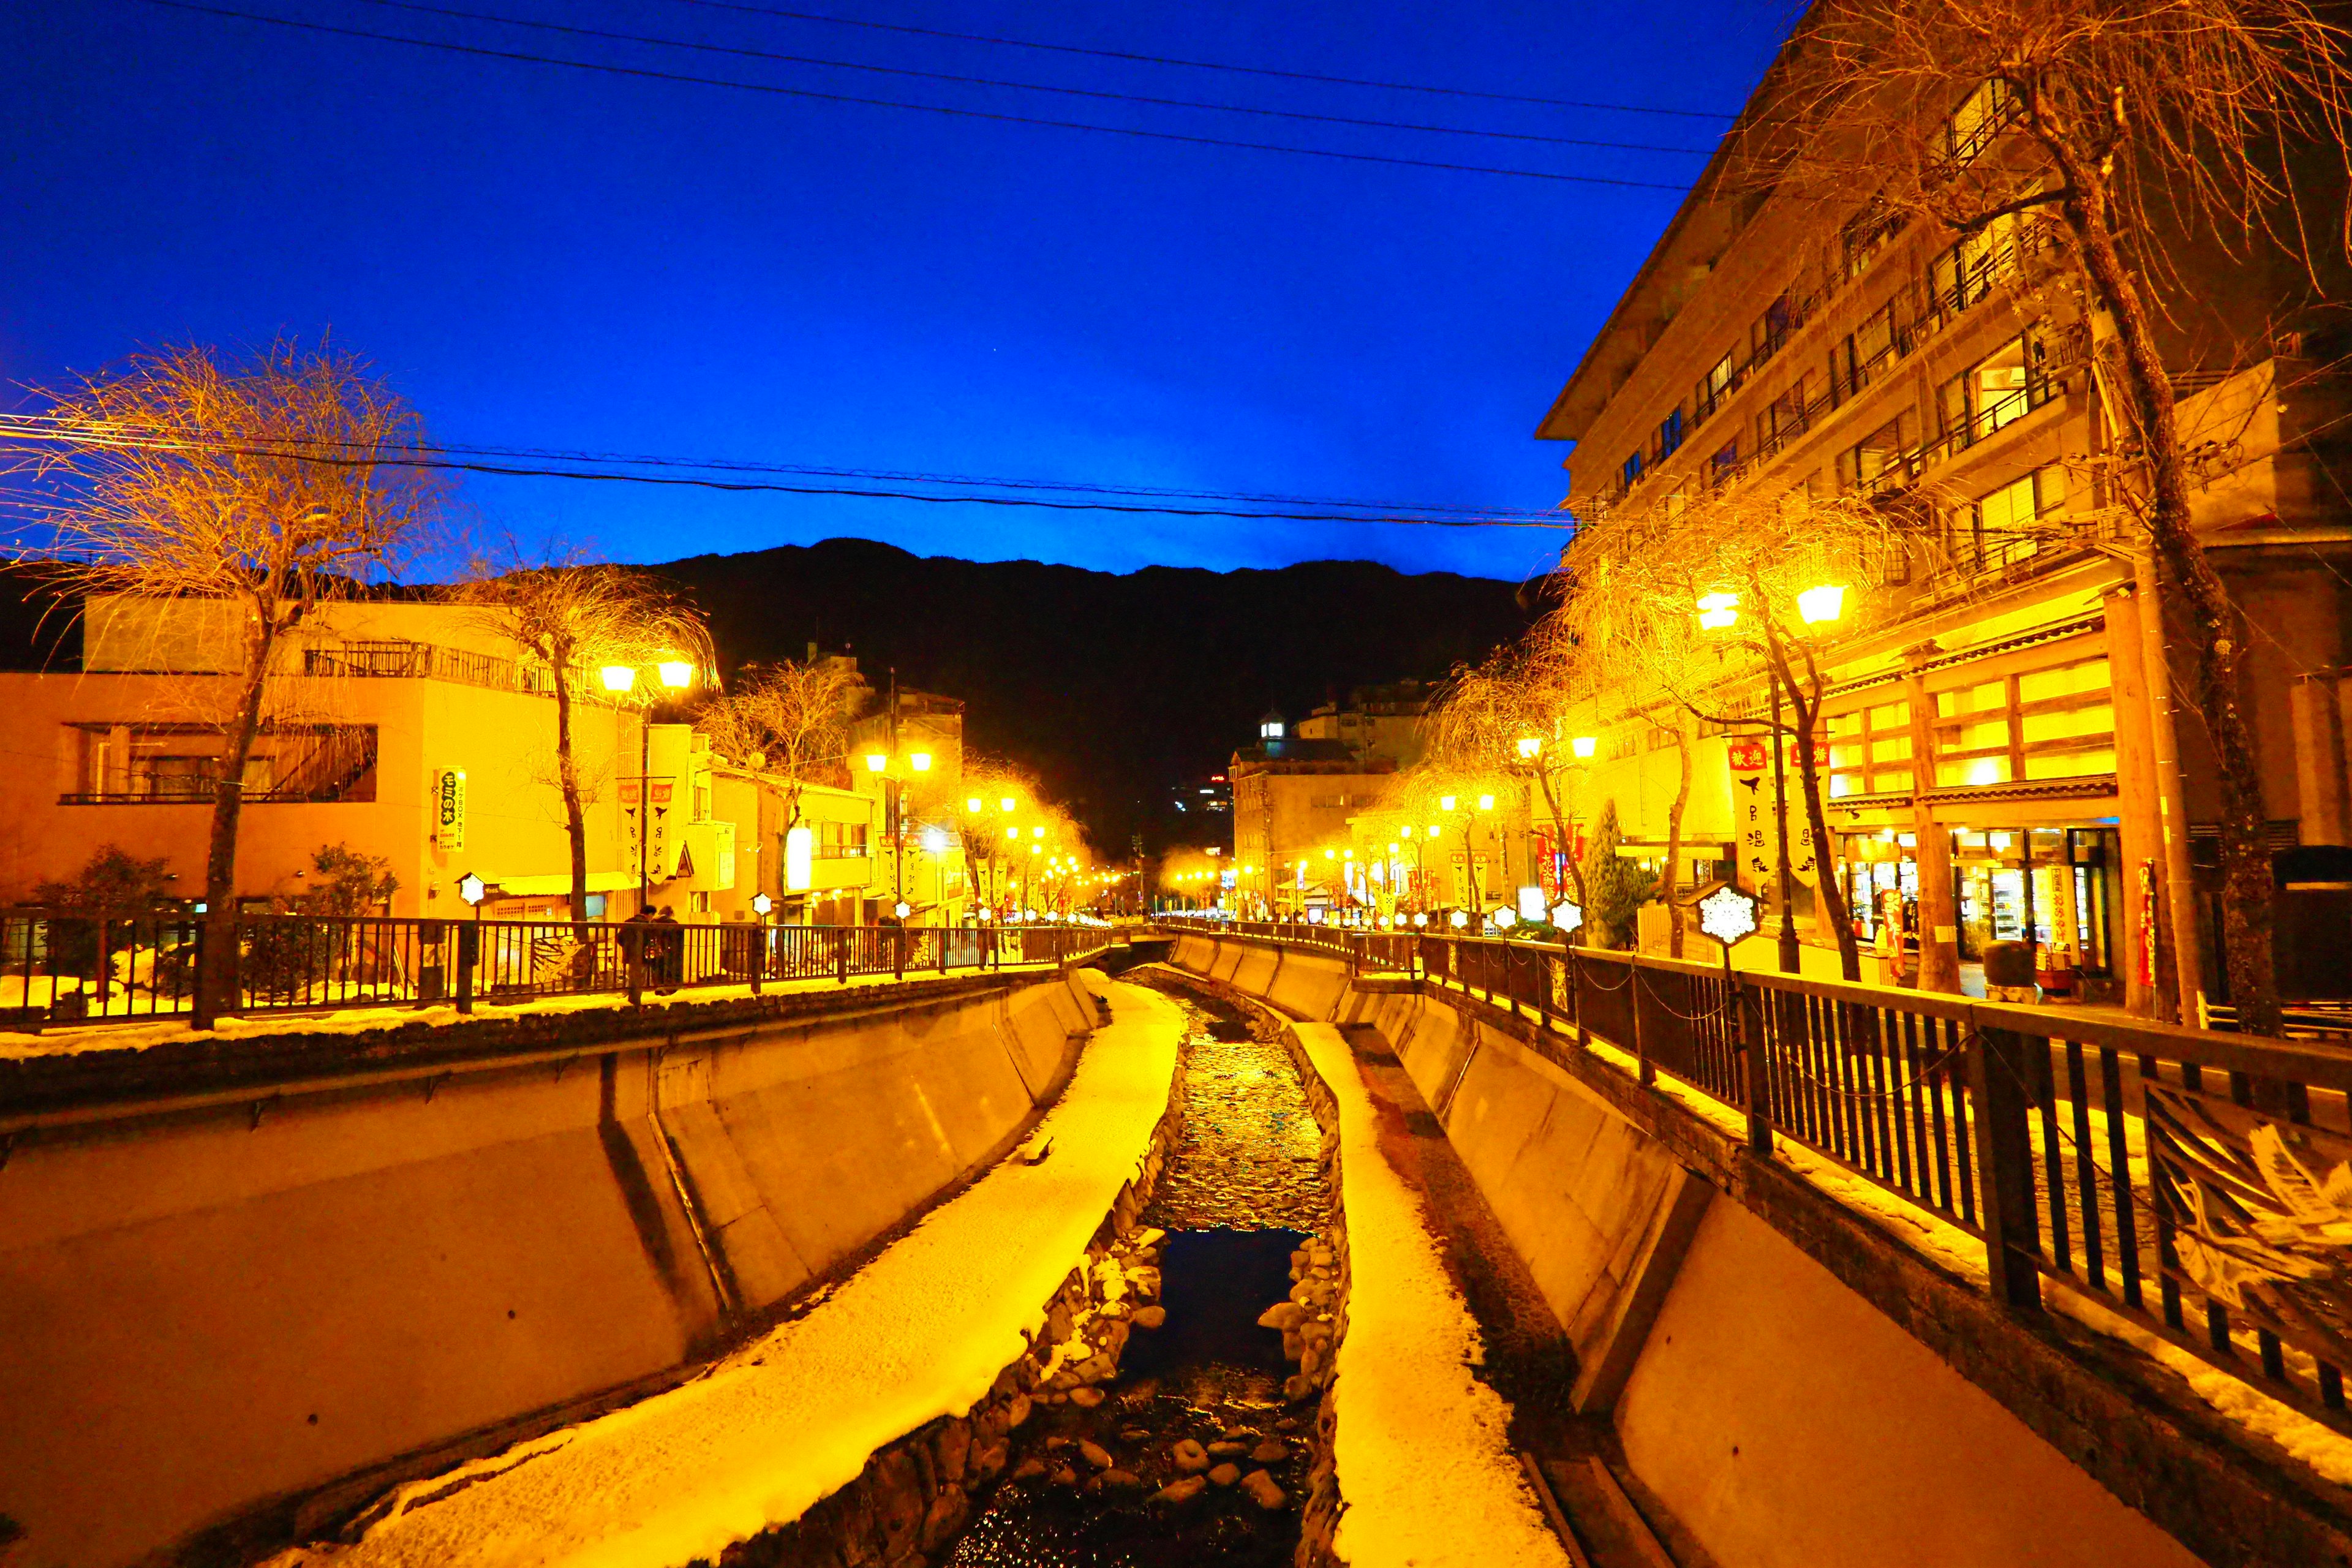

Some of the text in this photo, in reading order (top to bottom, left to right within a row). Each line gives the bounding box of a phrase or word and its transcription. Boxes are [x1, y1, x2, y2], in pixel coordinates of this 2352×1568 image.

[1731, 749, 1763, 767] 歓迎
[443, 775, 454, 822] モミの木
[1739, 777, 1770, 873] 下呂温泉
[1542, 854, 1555, 897] 花火物語
[2054, 894, 2066, 941] おみやげ
